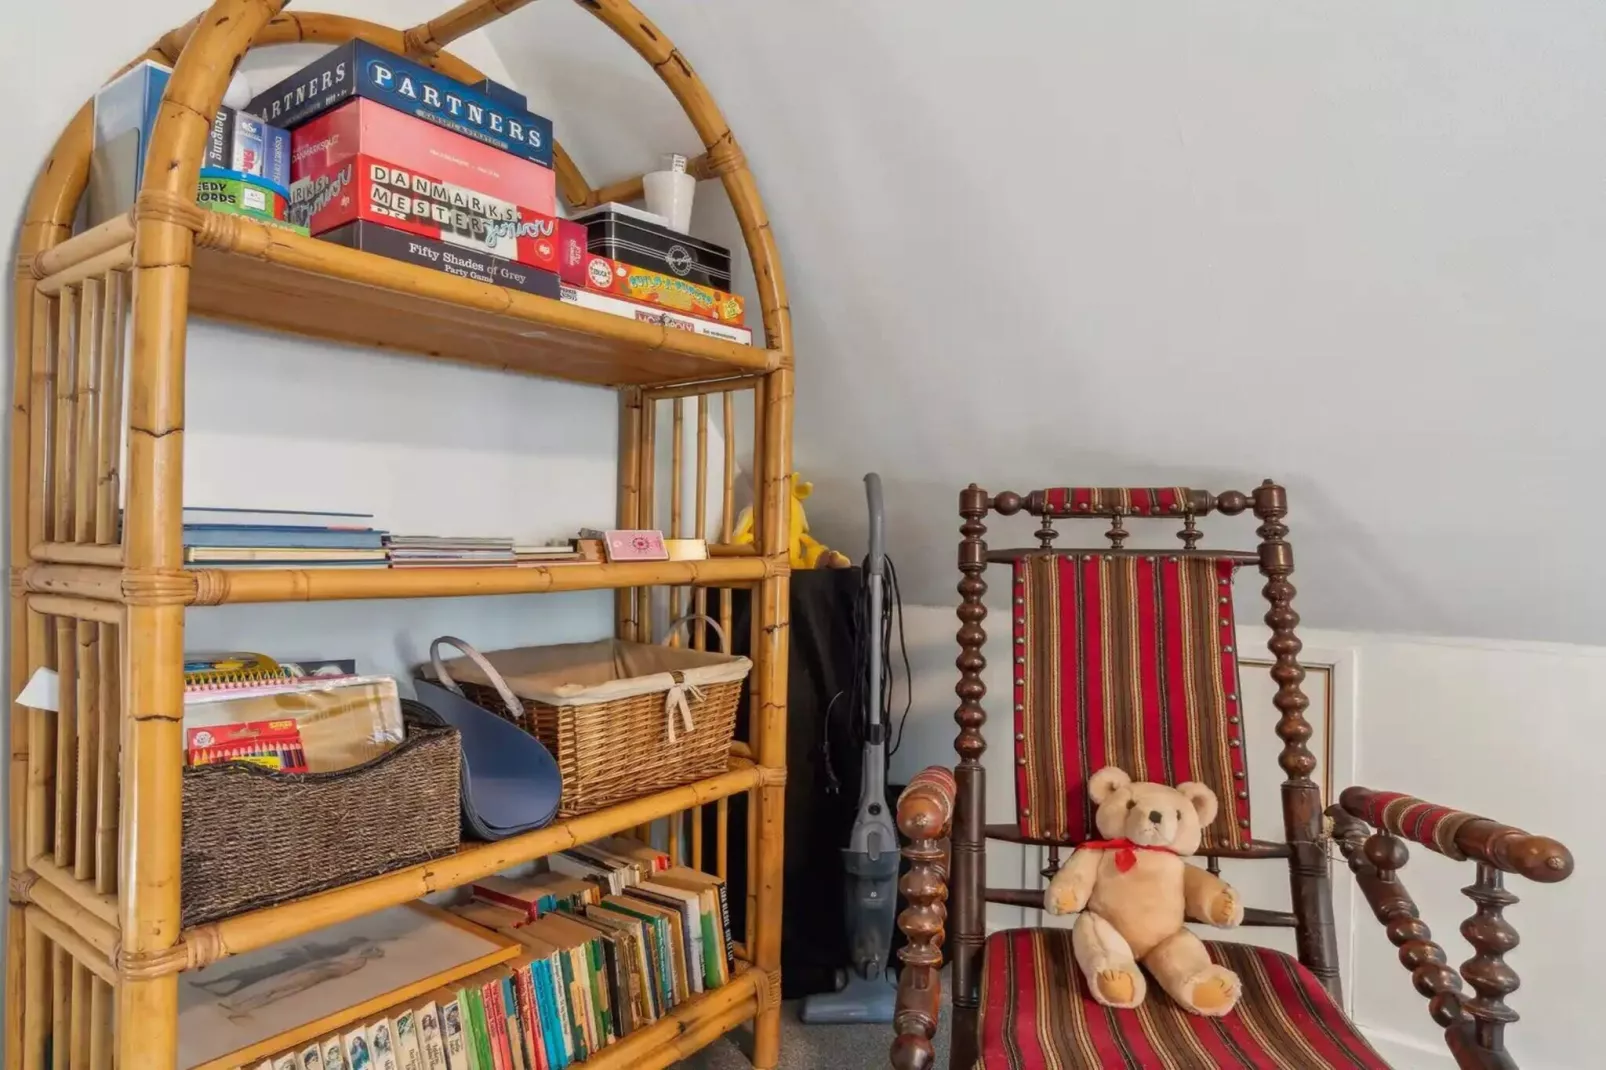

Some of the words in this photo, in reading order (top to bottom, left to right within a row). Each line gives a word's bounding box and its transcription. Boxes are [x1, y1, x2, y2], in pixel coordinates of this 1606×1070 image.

[262, 62, 346, 121] ARTNERS
[374, 64, 541, 148] PARTNERS
[372, 187, 485, 231] MESTER
[374, 166, 513, 220] DANMARKS
[408, 242, 440, 262] Fifty
[442, 252, 484, 272] Shades
[486, 265, 498, 275] of
[500, 268, 527, 285] Grey
[444, 264, 469, 278] Party
[469, 271, 494, 284] Game
